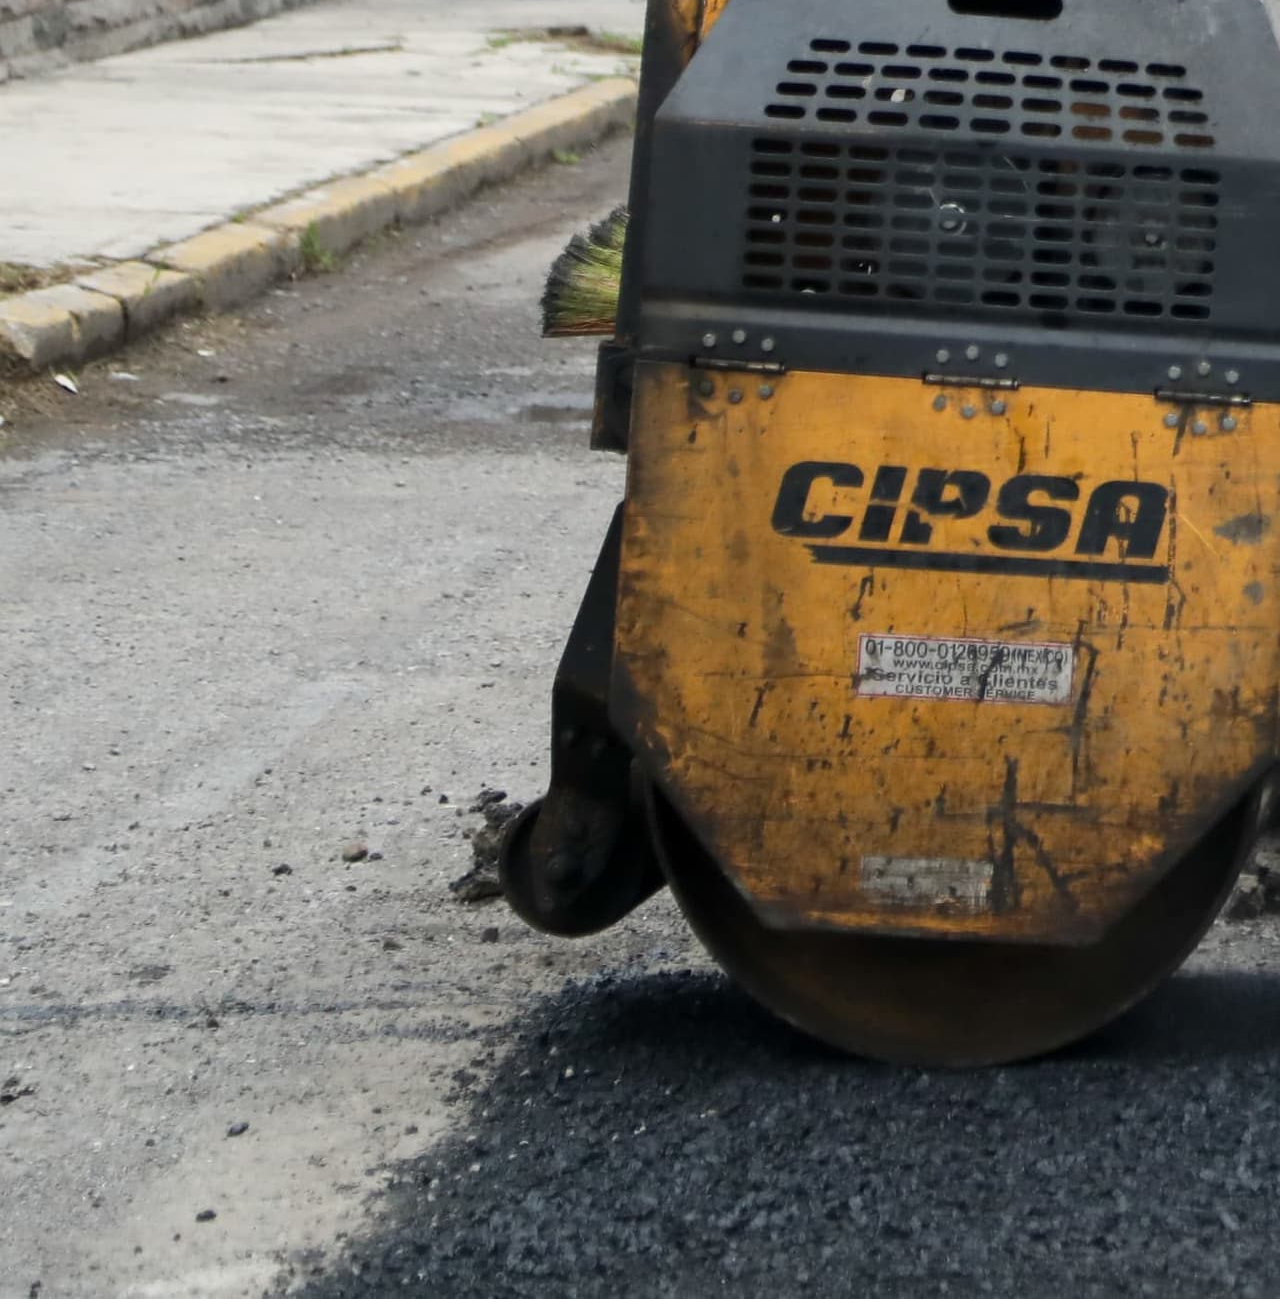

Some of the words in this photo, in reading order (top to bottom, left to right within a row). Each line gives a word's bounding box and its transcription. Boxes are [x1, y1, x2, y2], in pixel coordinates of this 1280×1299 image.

[770, 460, 1170, 560] CIPSA
[873, 666, 953, 685] Servicio
[959, 675, 970, 686] a
[895, 684, 972, 697] CUSTOMER
[978, 687, 1036, 700] ERVICE
